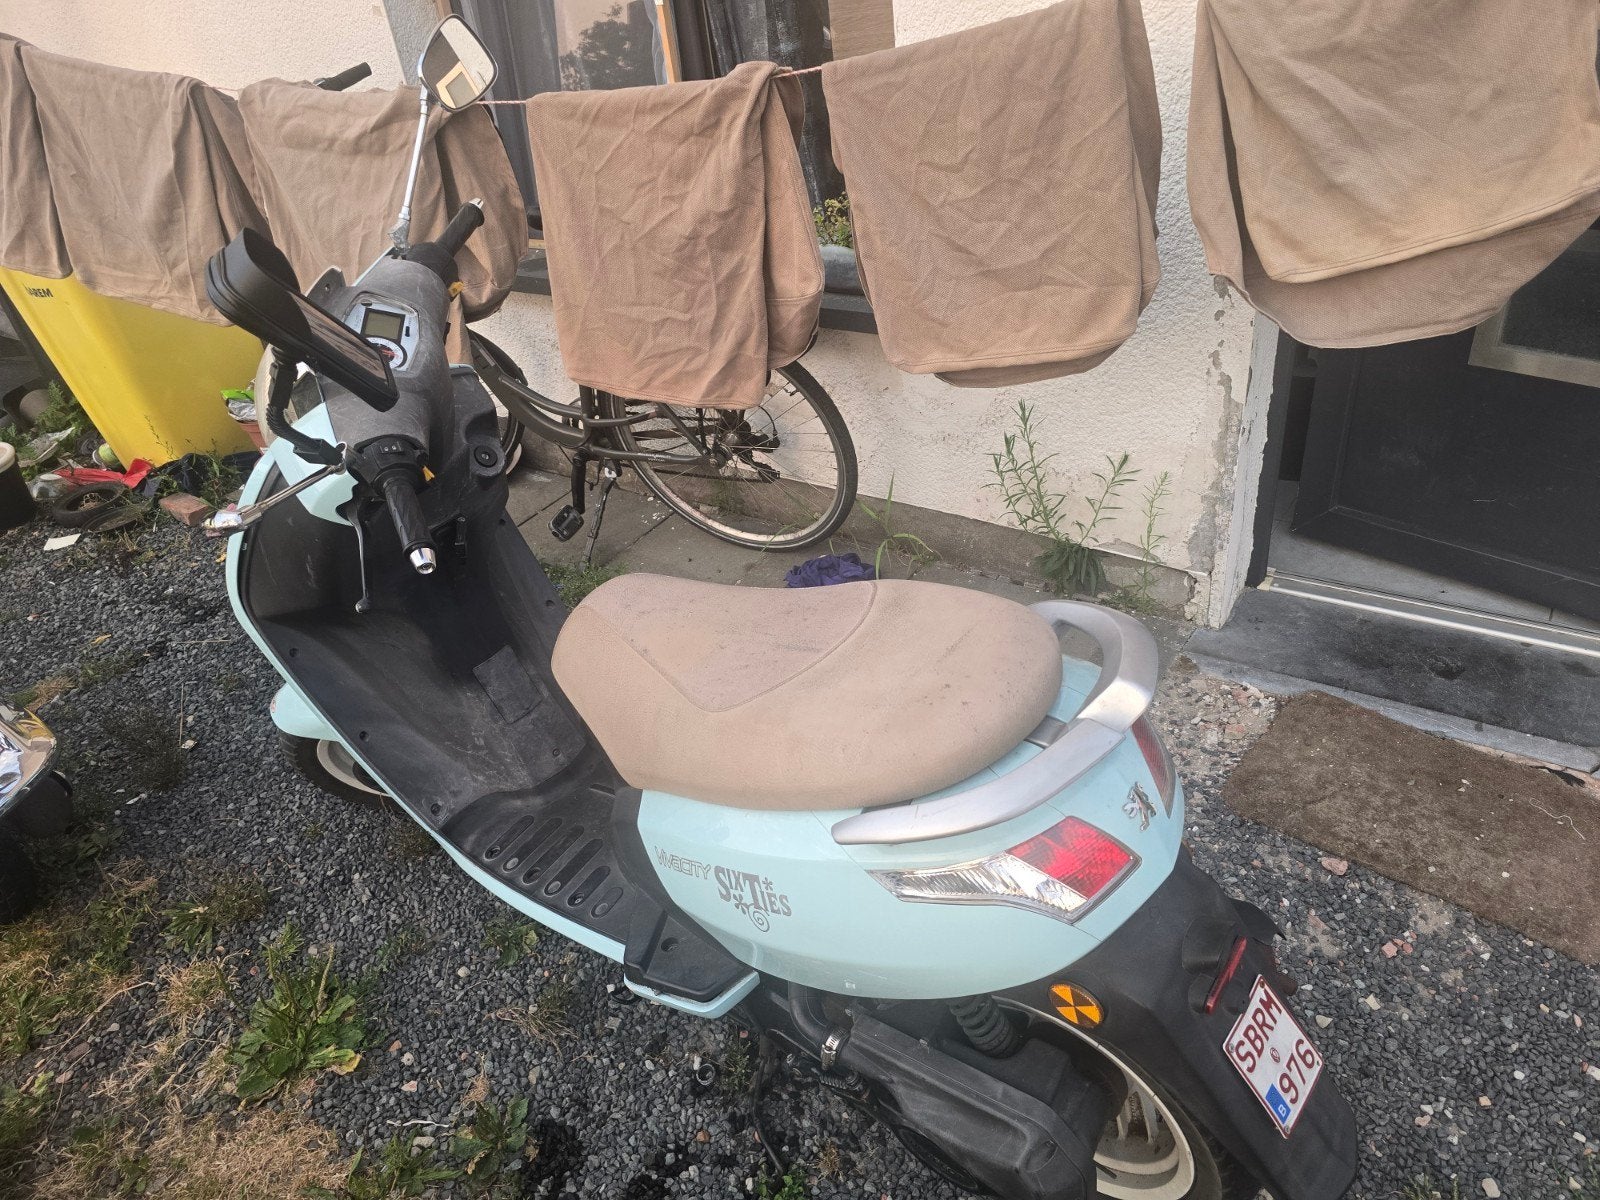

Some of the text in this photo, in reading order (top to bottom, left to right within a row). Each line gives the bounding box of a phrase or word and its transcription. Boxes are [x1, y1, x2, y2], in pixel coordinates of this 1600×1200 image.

[713, 865, 792, 916] SIXTIES
[1235, 989, 1282, 1073] SBRM
[1279, 1038, 1315, 1105] 976
[1277, 1104, 1287, 1118] B
